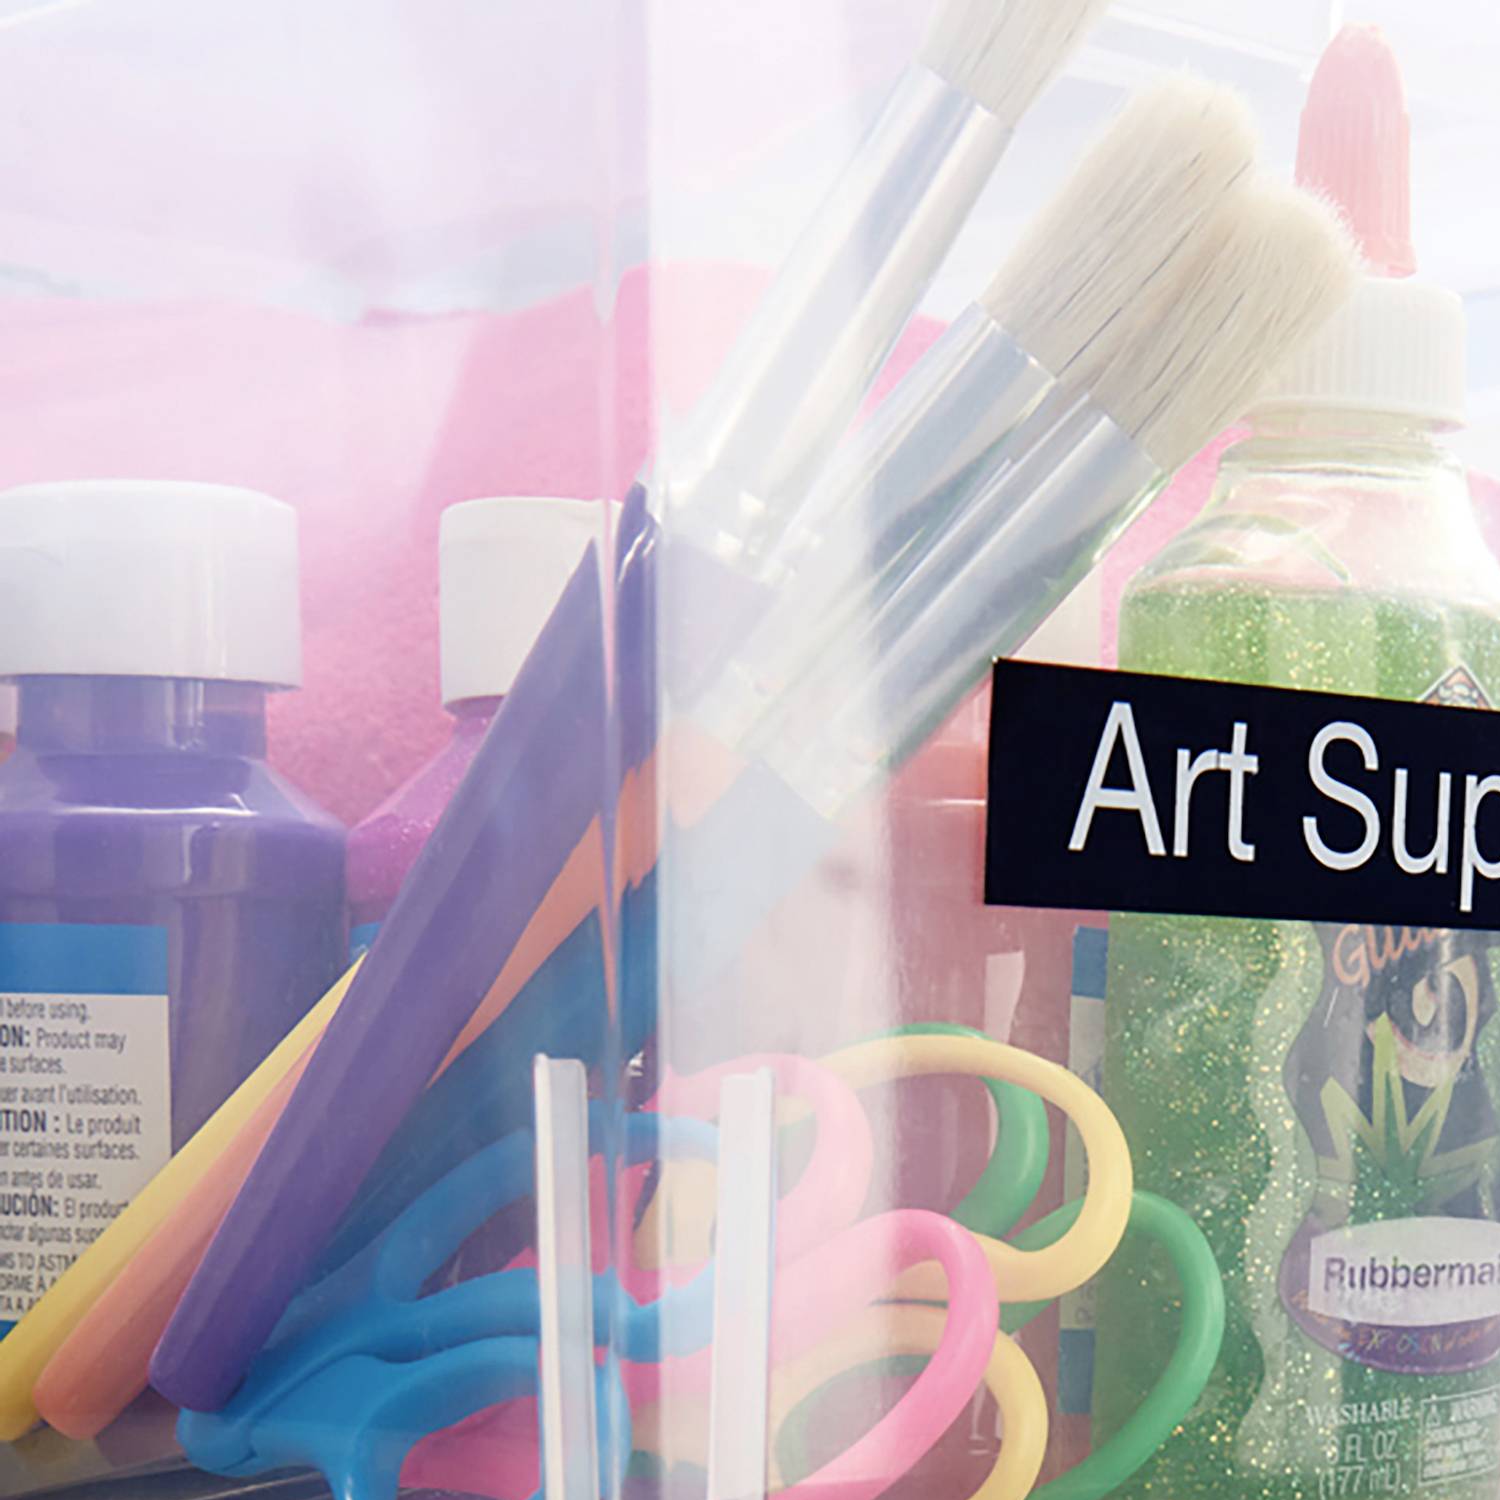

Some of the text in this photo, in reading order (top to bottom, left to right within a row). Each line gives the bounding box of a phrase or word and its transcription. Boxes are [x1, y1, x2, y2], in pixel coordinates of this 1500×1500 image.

[1067, 700, 1259, 862] Art
[6, 997, 46, 1019] before
[36, 1027, 91, 1049] Product
[95, 1033, 127, 1054] may
[66, 1112, 84, 1135] Le
[87, 1113, 141, 1138] produit
[73, 1138, 140, 1161] surfaces.
[46, 1168, 63, 1189] de
[63, 1196, 76, 1218] El
[1304, 1396, 1413, 1428] WASHABLE
[1345, 1432, 1367, 1463] FL
[1374, 1429, 1399, 1461] OZ
